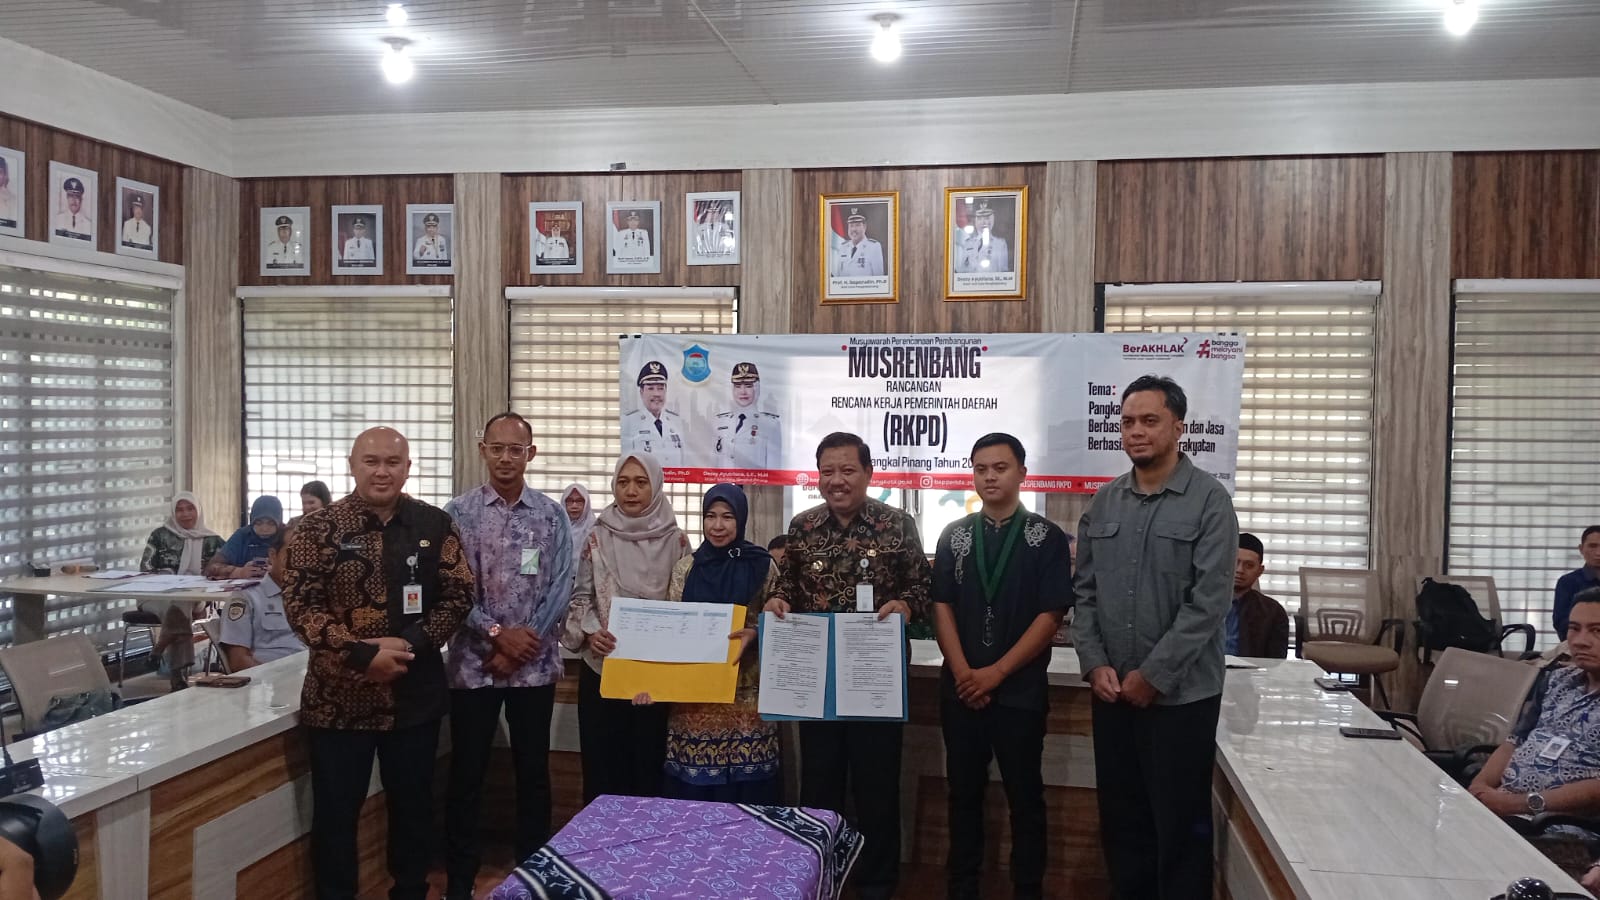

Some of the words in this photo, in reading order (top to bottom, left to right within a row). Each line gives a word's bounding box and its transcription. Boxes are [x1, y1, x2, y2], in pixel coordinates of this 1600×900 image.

[850, 337, 891, 347] Musyawarah
[935, 336, 982, 347] Pembangunan
[1122, 344, 1185, 353] BerAKHLAK
[848, 346, 982, 379] MUSRENBANG
[886, 380, 942, 393] RANCANGAN
[1088, 382, 1117, 396] Tema:
[831, 396, 872, 409] RENCANA
[873, 396, 903, 409] KERJA
[904, 396, 960, 409] PEMERINTAH
[961, 397, 998, 409] DAERAH
[1088, 401, 1121, 419] Pangka
[883, 411, 948, 454] (RKPD)
[1088, 419, 1122, 433] Berbasi
[1189, 420, 1204, 434] dan
[1205, 420, 1225, 435] Jasa
[1087, 437, 1124, 451] Berbasi
[1178, 438, 1216, 456] rakyatan
[871, 456, 901, 471] angkal
[902, 456, 932, 471] Pinang
[933, 457, 960, 468] Tahun
[962, 457, 974, 469] 20
[1020, 480, 1056, 489] USRENBANG
